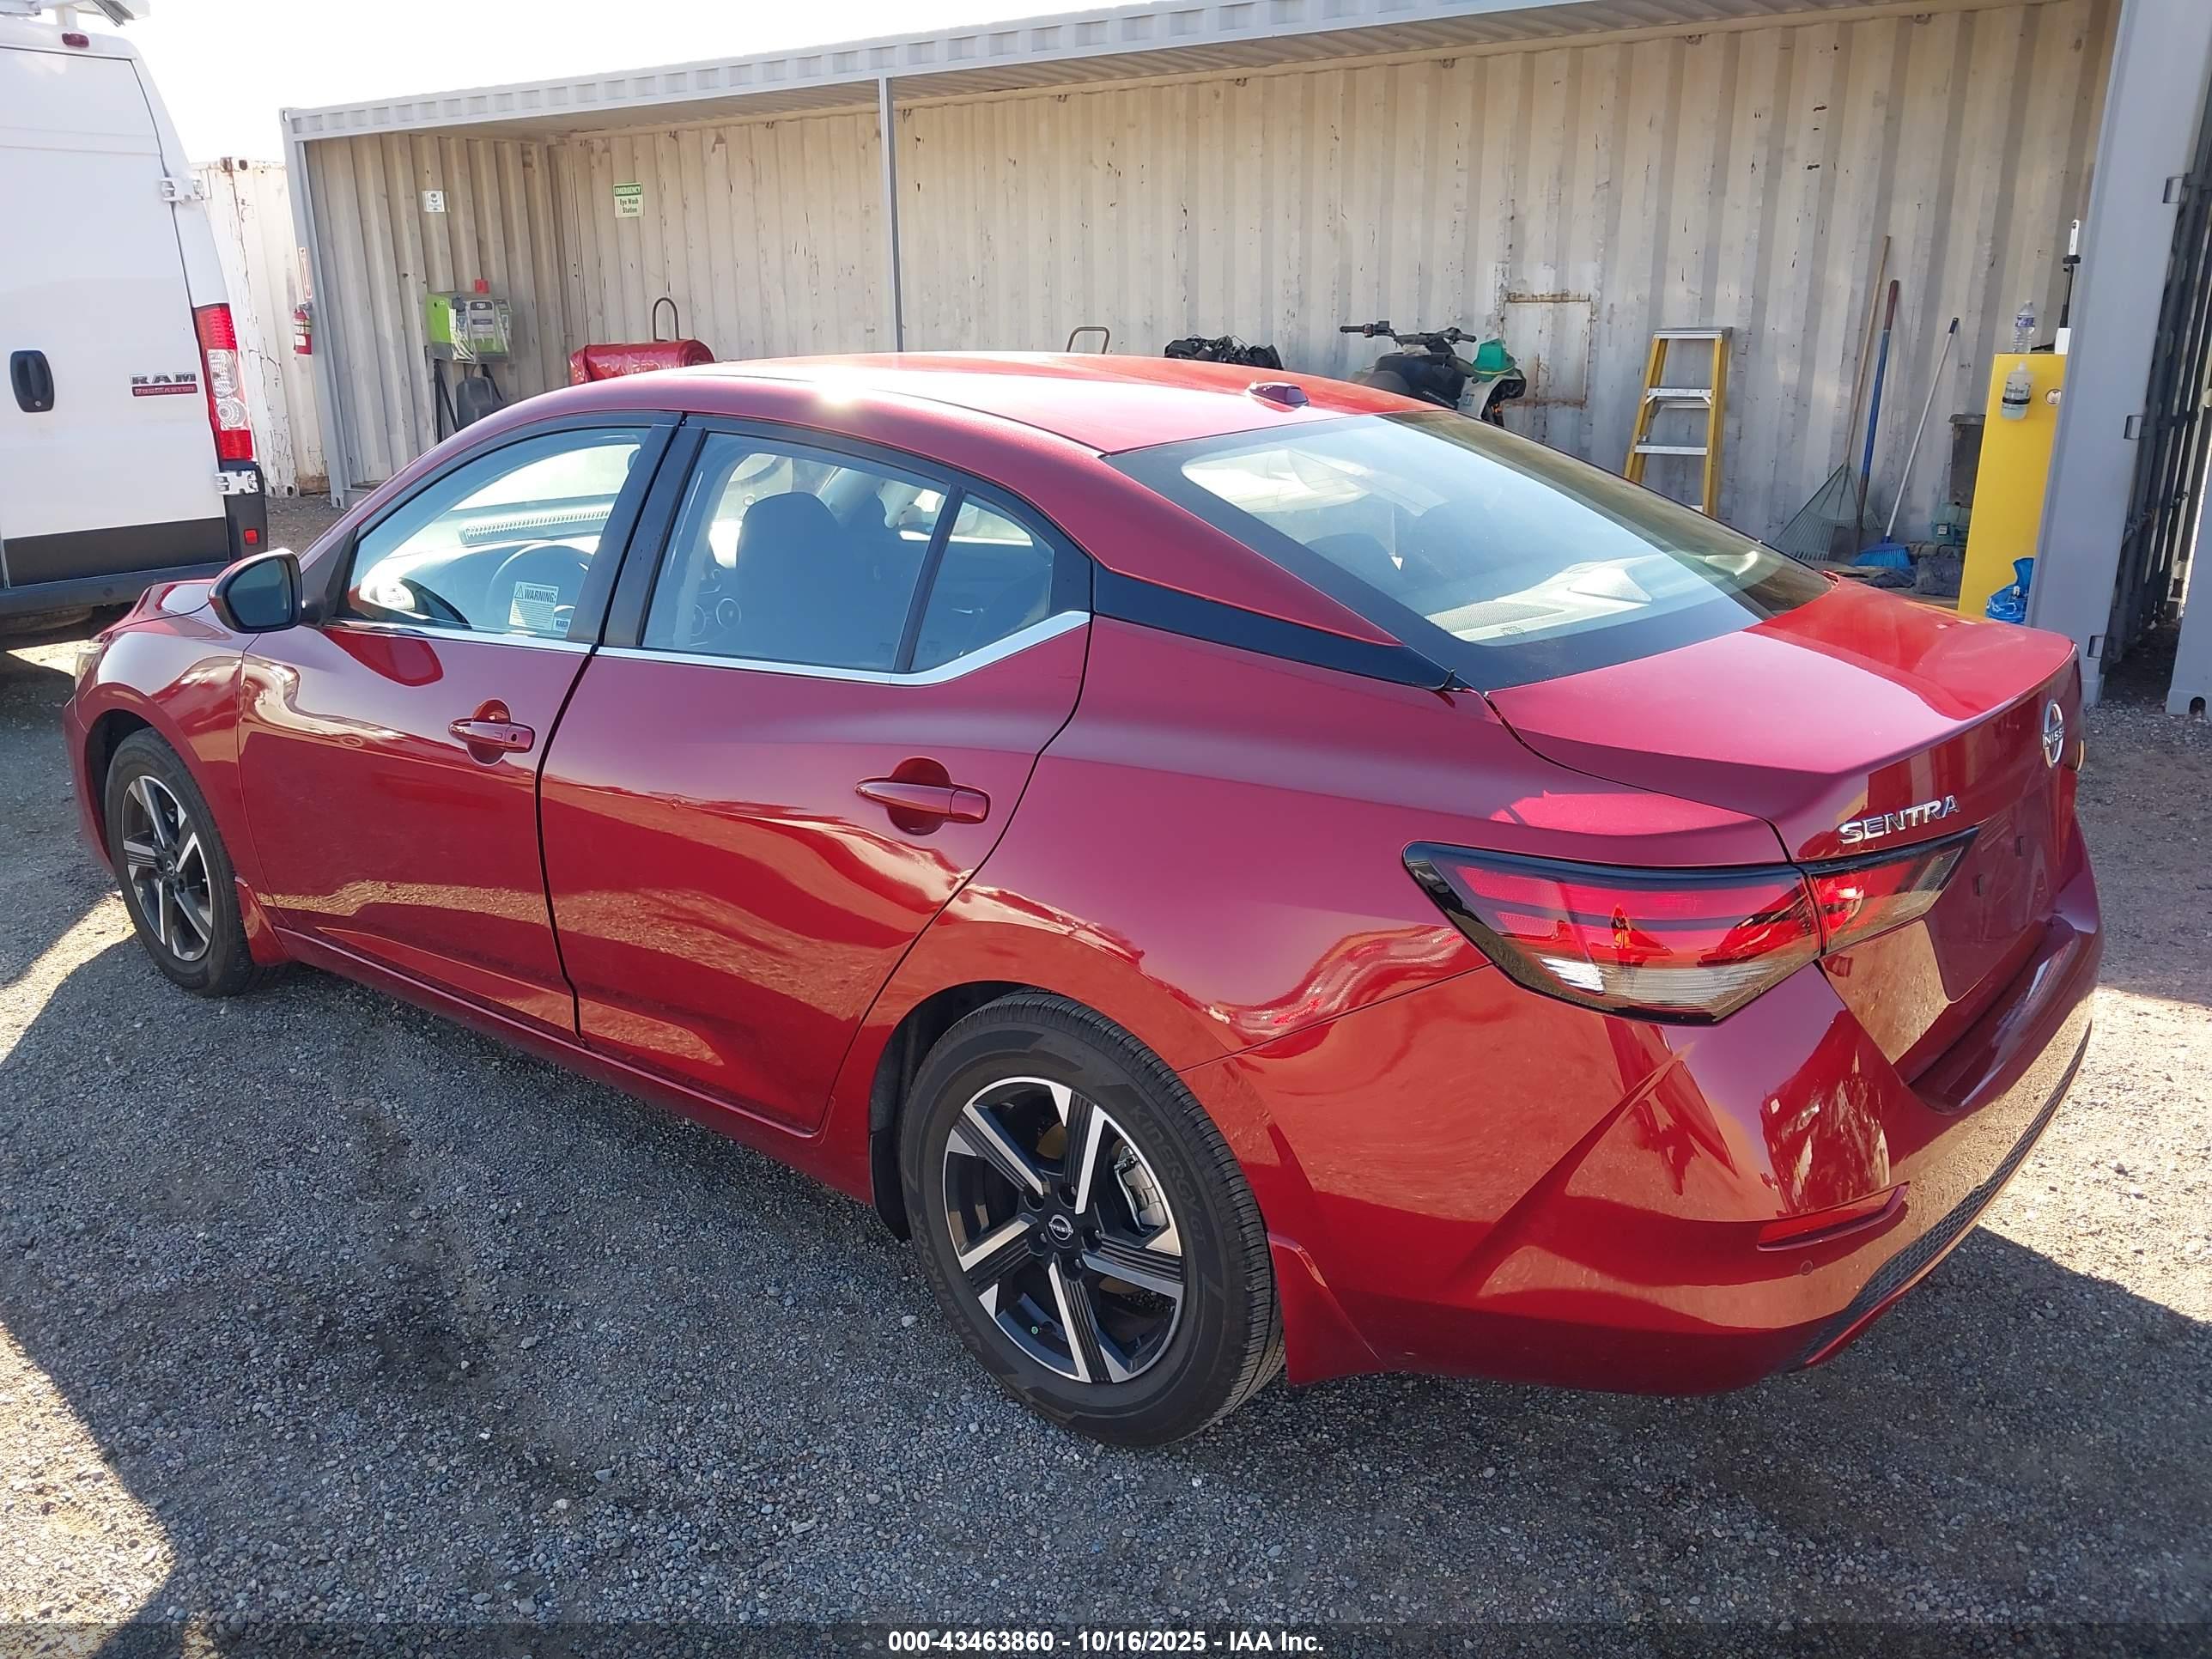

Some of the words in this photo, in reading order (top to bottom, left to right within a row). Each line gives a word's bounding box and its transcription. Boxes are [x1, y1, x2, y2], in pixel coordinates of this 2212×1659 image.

[131, 373, 197, 385] RAM
[524, 588, 556, 604] WARNING:
[2044, 727, 2064, 746] NISS
[1838, 795, 1960, 844] SENTRA
